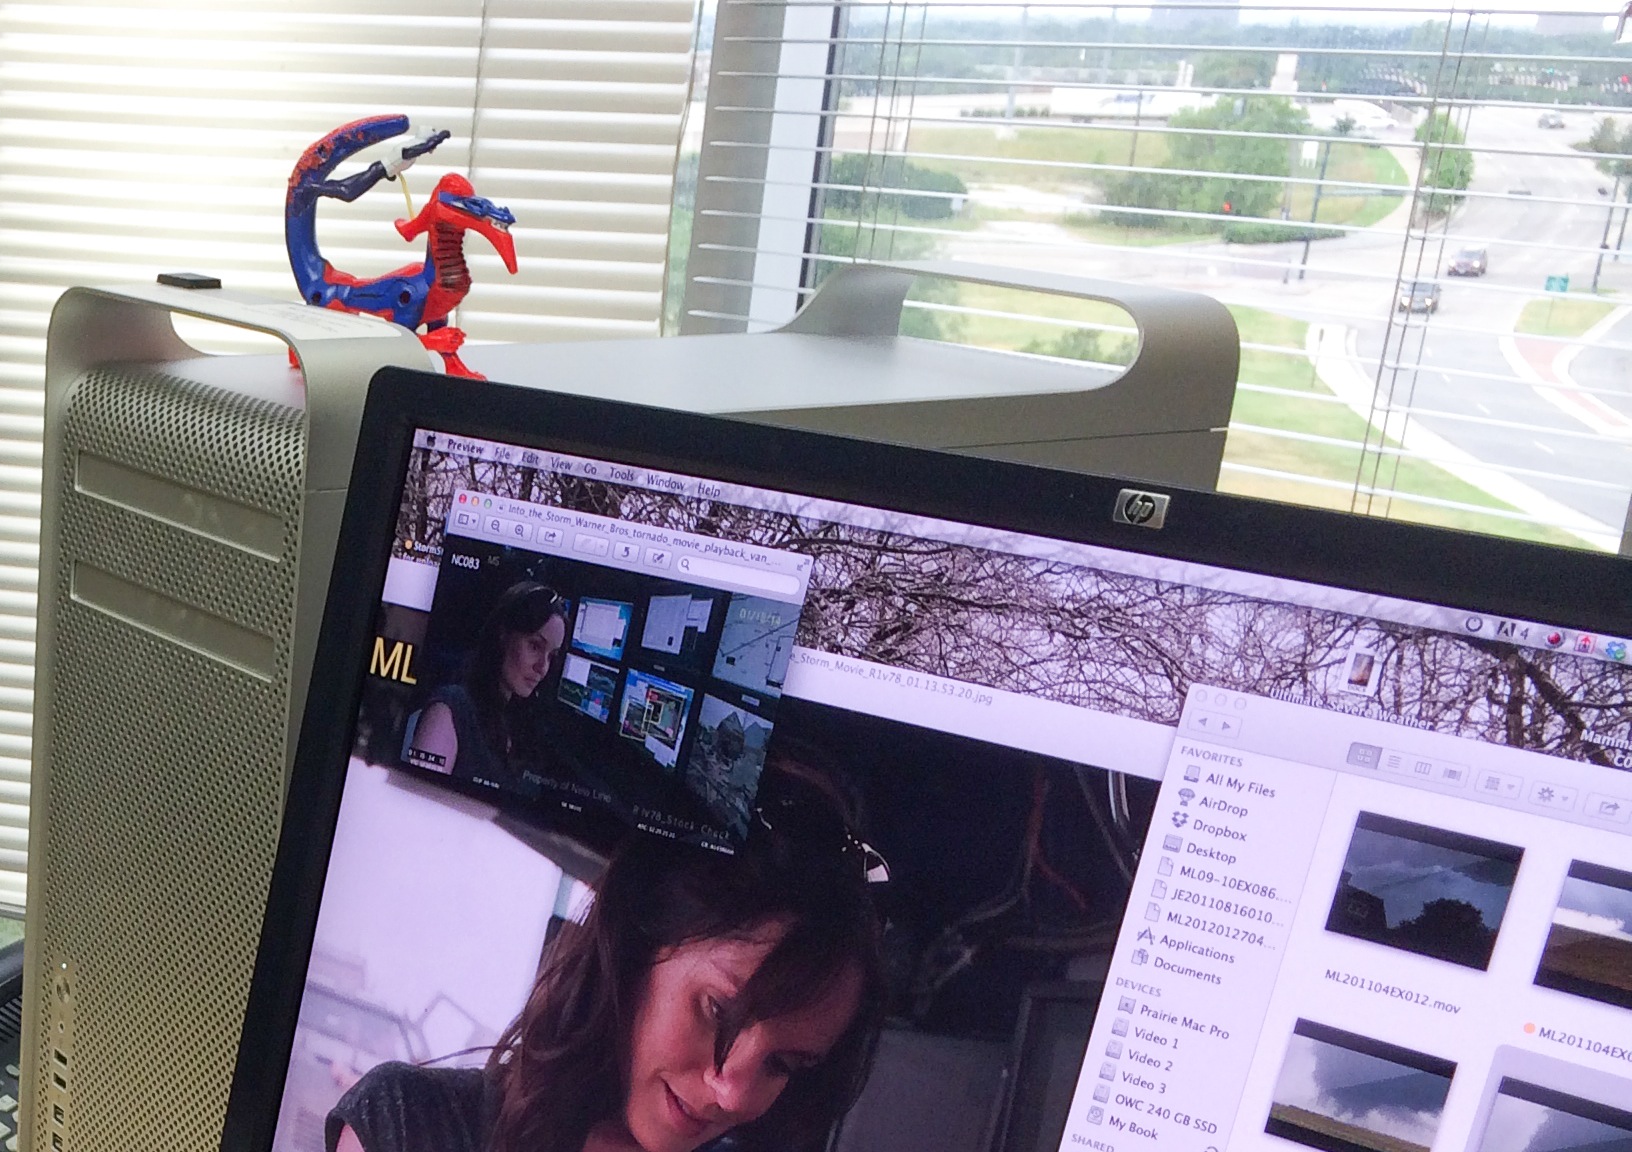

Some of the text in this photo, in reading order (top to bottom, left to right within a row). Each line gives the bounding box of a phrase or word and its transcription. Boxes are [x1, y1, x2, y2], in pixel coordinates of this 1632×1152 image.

[448, 437, 721, 499] Preview File Edit View Go Tools Window Help
[369, 634, 418, 686] ML
[1269, 687, 1434, 731] Ultimate Severe Weather
[1181, 745, 1244, 767] FAVORITES
[1206, 773, 1276, 798] All My Files
[1199, 797, 1248, 818] AirDrop
[1193, 819, 1247, 843] Dropbox
[1186, 843, 1237, 865] Desktop
[1160, 935, 1235, 964] Applications
[1154, 957, 1221, 985] Documents
[1116, 977, 1161, 997] DEVICES
[1325, 968, 1461, 1015] ML201104EX012.mov
[1140, 1005, 1229, 1039] Prairie Mac Pro
[1135, 1027, 1178, 1049] Video 1
[1128, 1049, 1173, 1071] Video 2
[1122, 1071, 1167, 1094] Video 3
[1115, 1094, 1217, 1134] OWC 240 GB SSD
[1109, 1115, 1159, 1140] My Book
